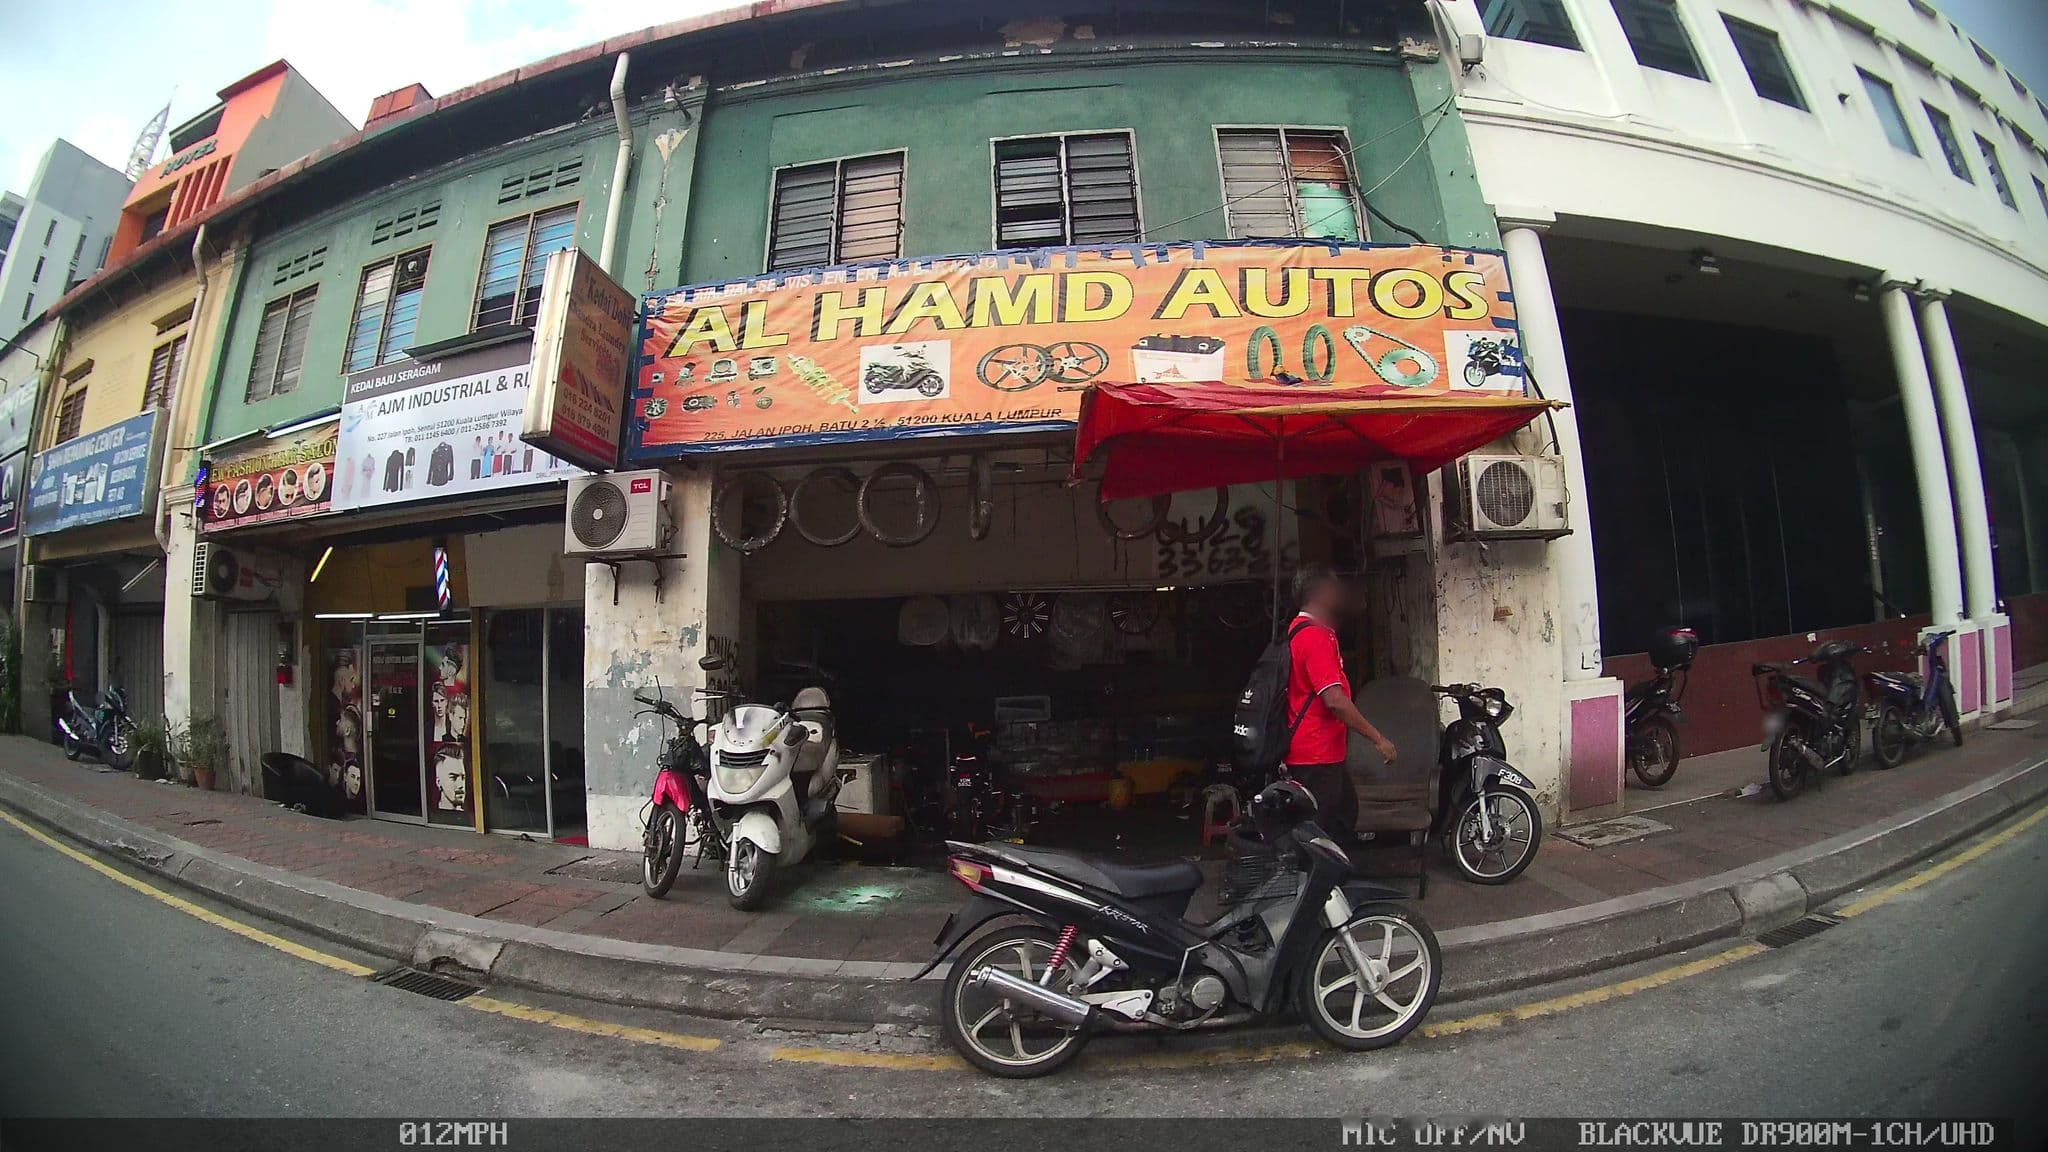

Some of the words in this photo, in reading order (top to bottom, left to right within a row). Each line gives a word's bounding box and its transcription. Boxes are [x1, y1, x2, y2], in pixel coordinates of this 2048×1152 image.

[664, 298, 790, 358] AL
[810, 271, 1135, 343] HAMD
[1151, 266, 1490, 321] AUTOS
[350, 379, 374, 394] KEDAI
[375, 373, 397, 388] BAJU
[397, 363, 442, 383] SERAGAM
[377, 398, 404, 417] AJM
[408, 379, 491, 410] INDUSTRIAL
[496, 375, 508, 392] &
[731, 426, 775, 440] JALAN
[819, 420, 859, 432] BATU
[897, 414, 938, 425] 51200
[941, 411, 993, 423] KUALA
[997, 408, 1062, 420] LUMPUR
